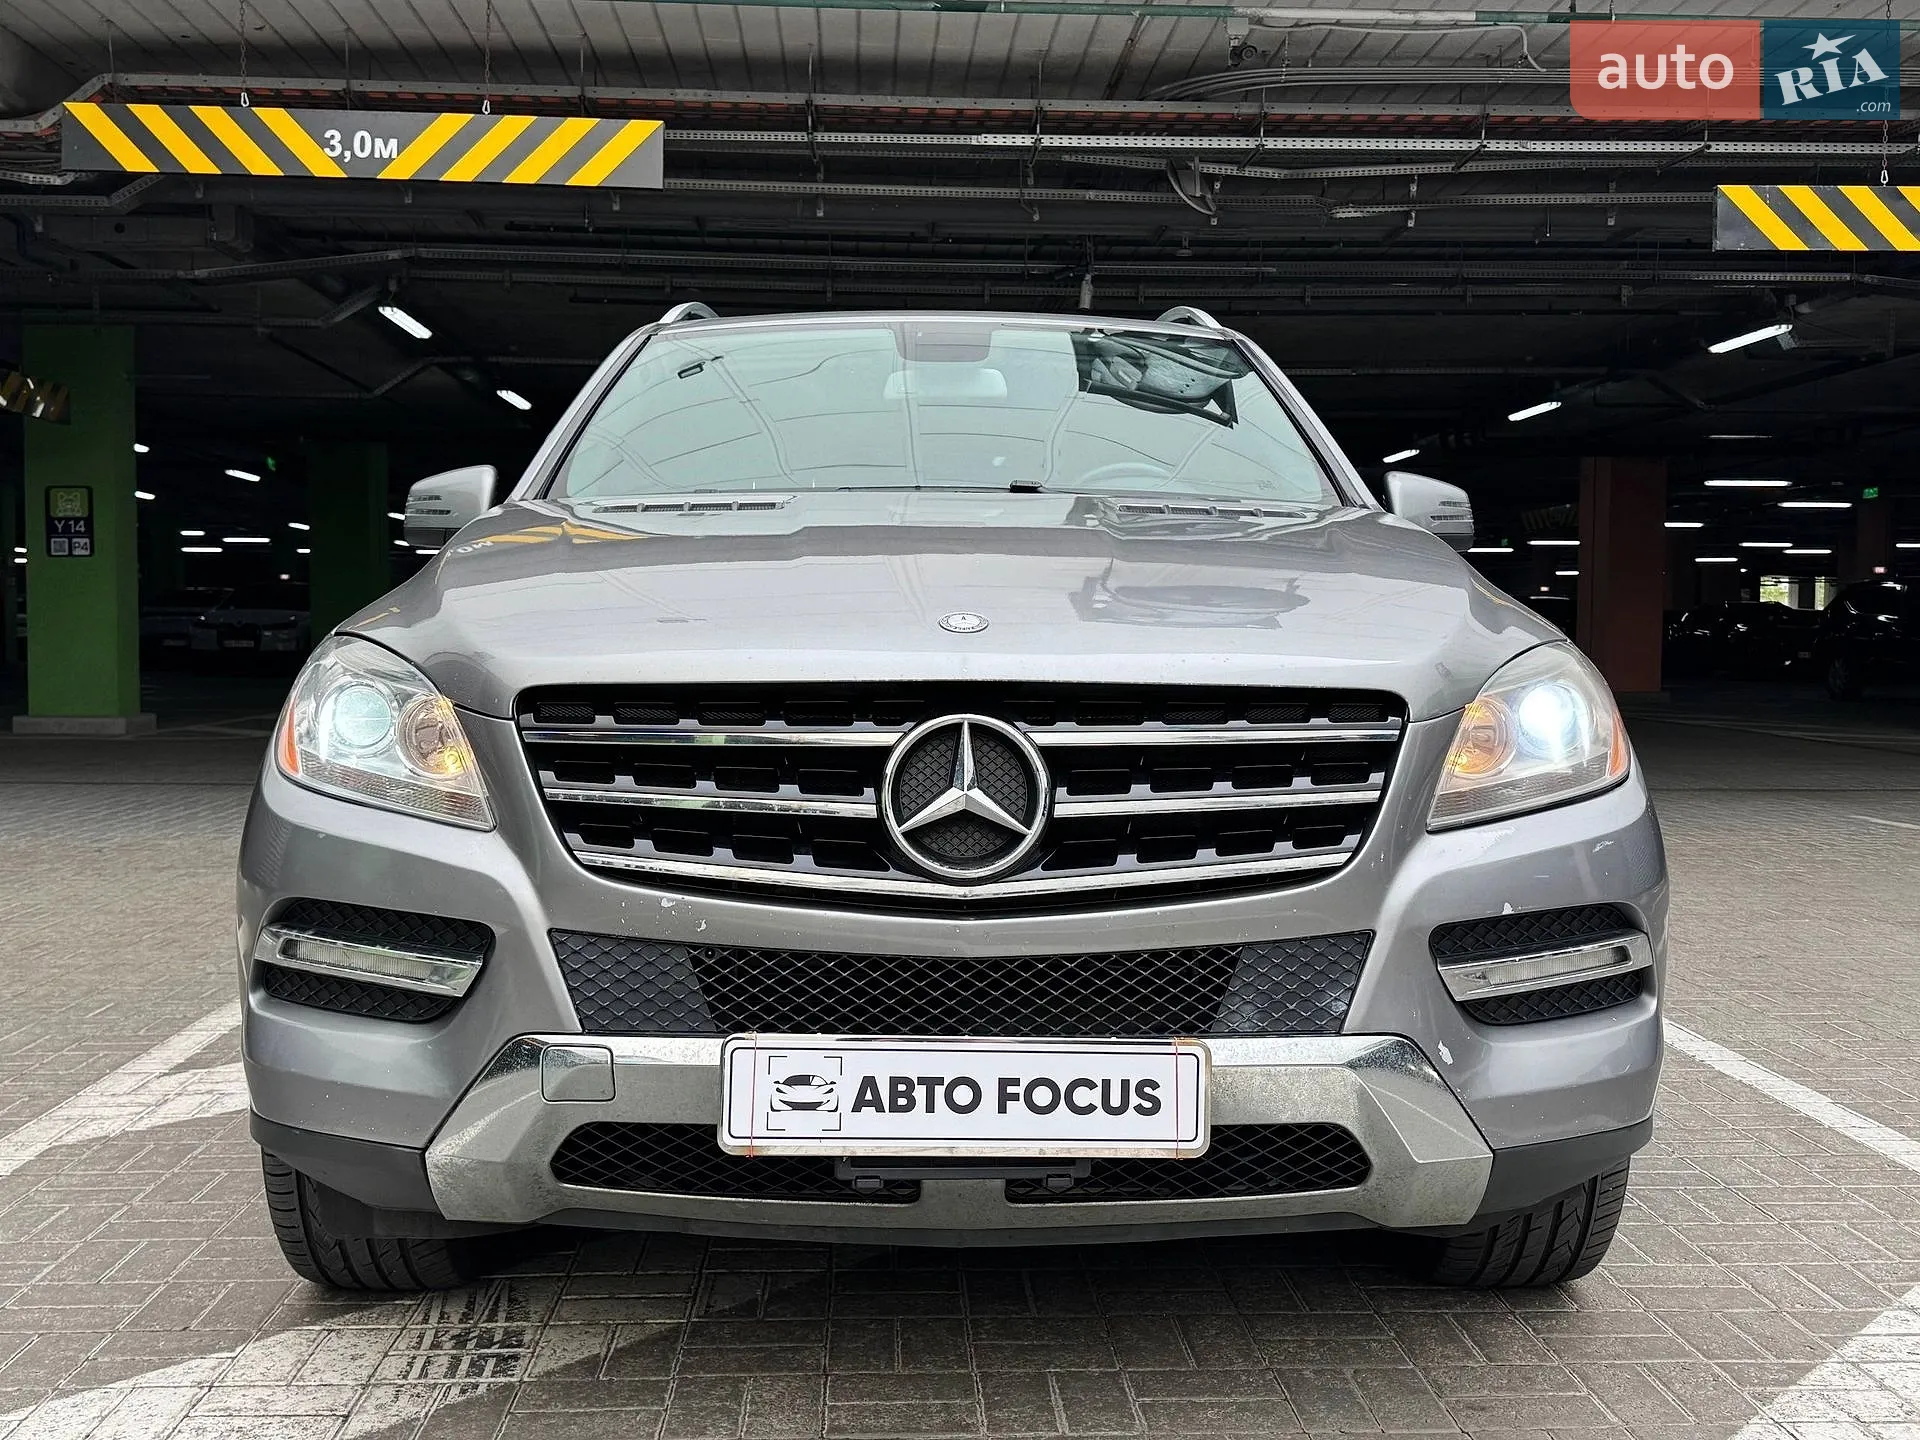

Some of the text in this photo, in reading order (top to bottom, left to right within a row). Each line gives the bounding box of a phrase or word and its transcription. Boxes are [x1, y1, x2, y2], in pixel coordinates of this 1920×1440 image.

[68, 520, 86, 533] 14
[851, 1076, 1162, 1116] АВТО FOCUS
